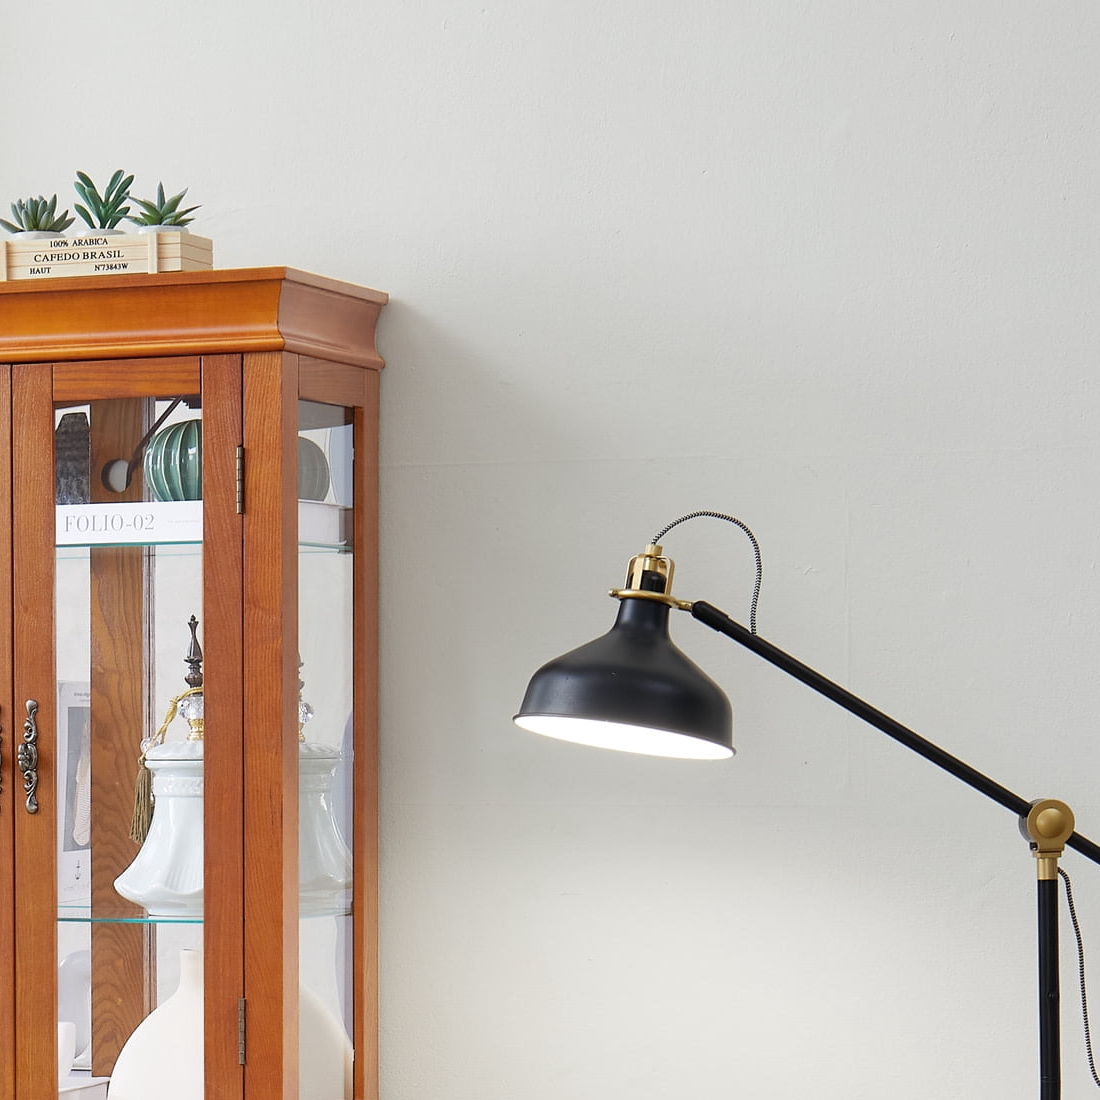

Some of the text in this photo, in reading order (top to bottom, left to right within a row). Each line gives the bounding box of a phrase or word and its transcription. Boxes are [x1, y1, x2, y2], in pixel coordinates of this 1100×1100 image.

[49, 237, 108, 248] 100% ARABICA
[82, 250, 125, 260] BRASIL
[29, 266, 52, 275] HAUT
[64, 513, 155, 532] FOLIO-02
